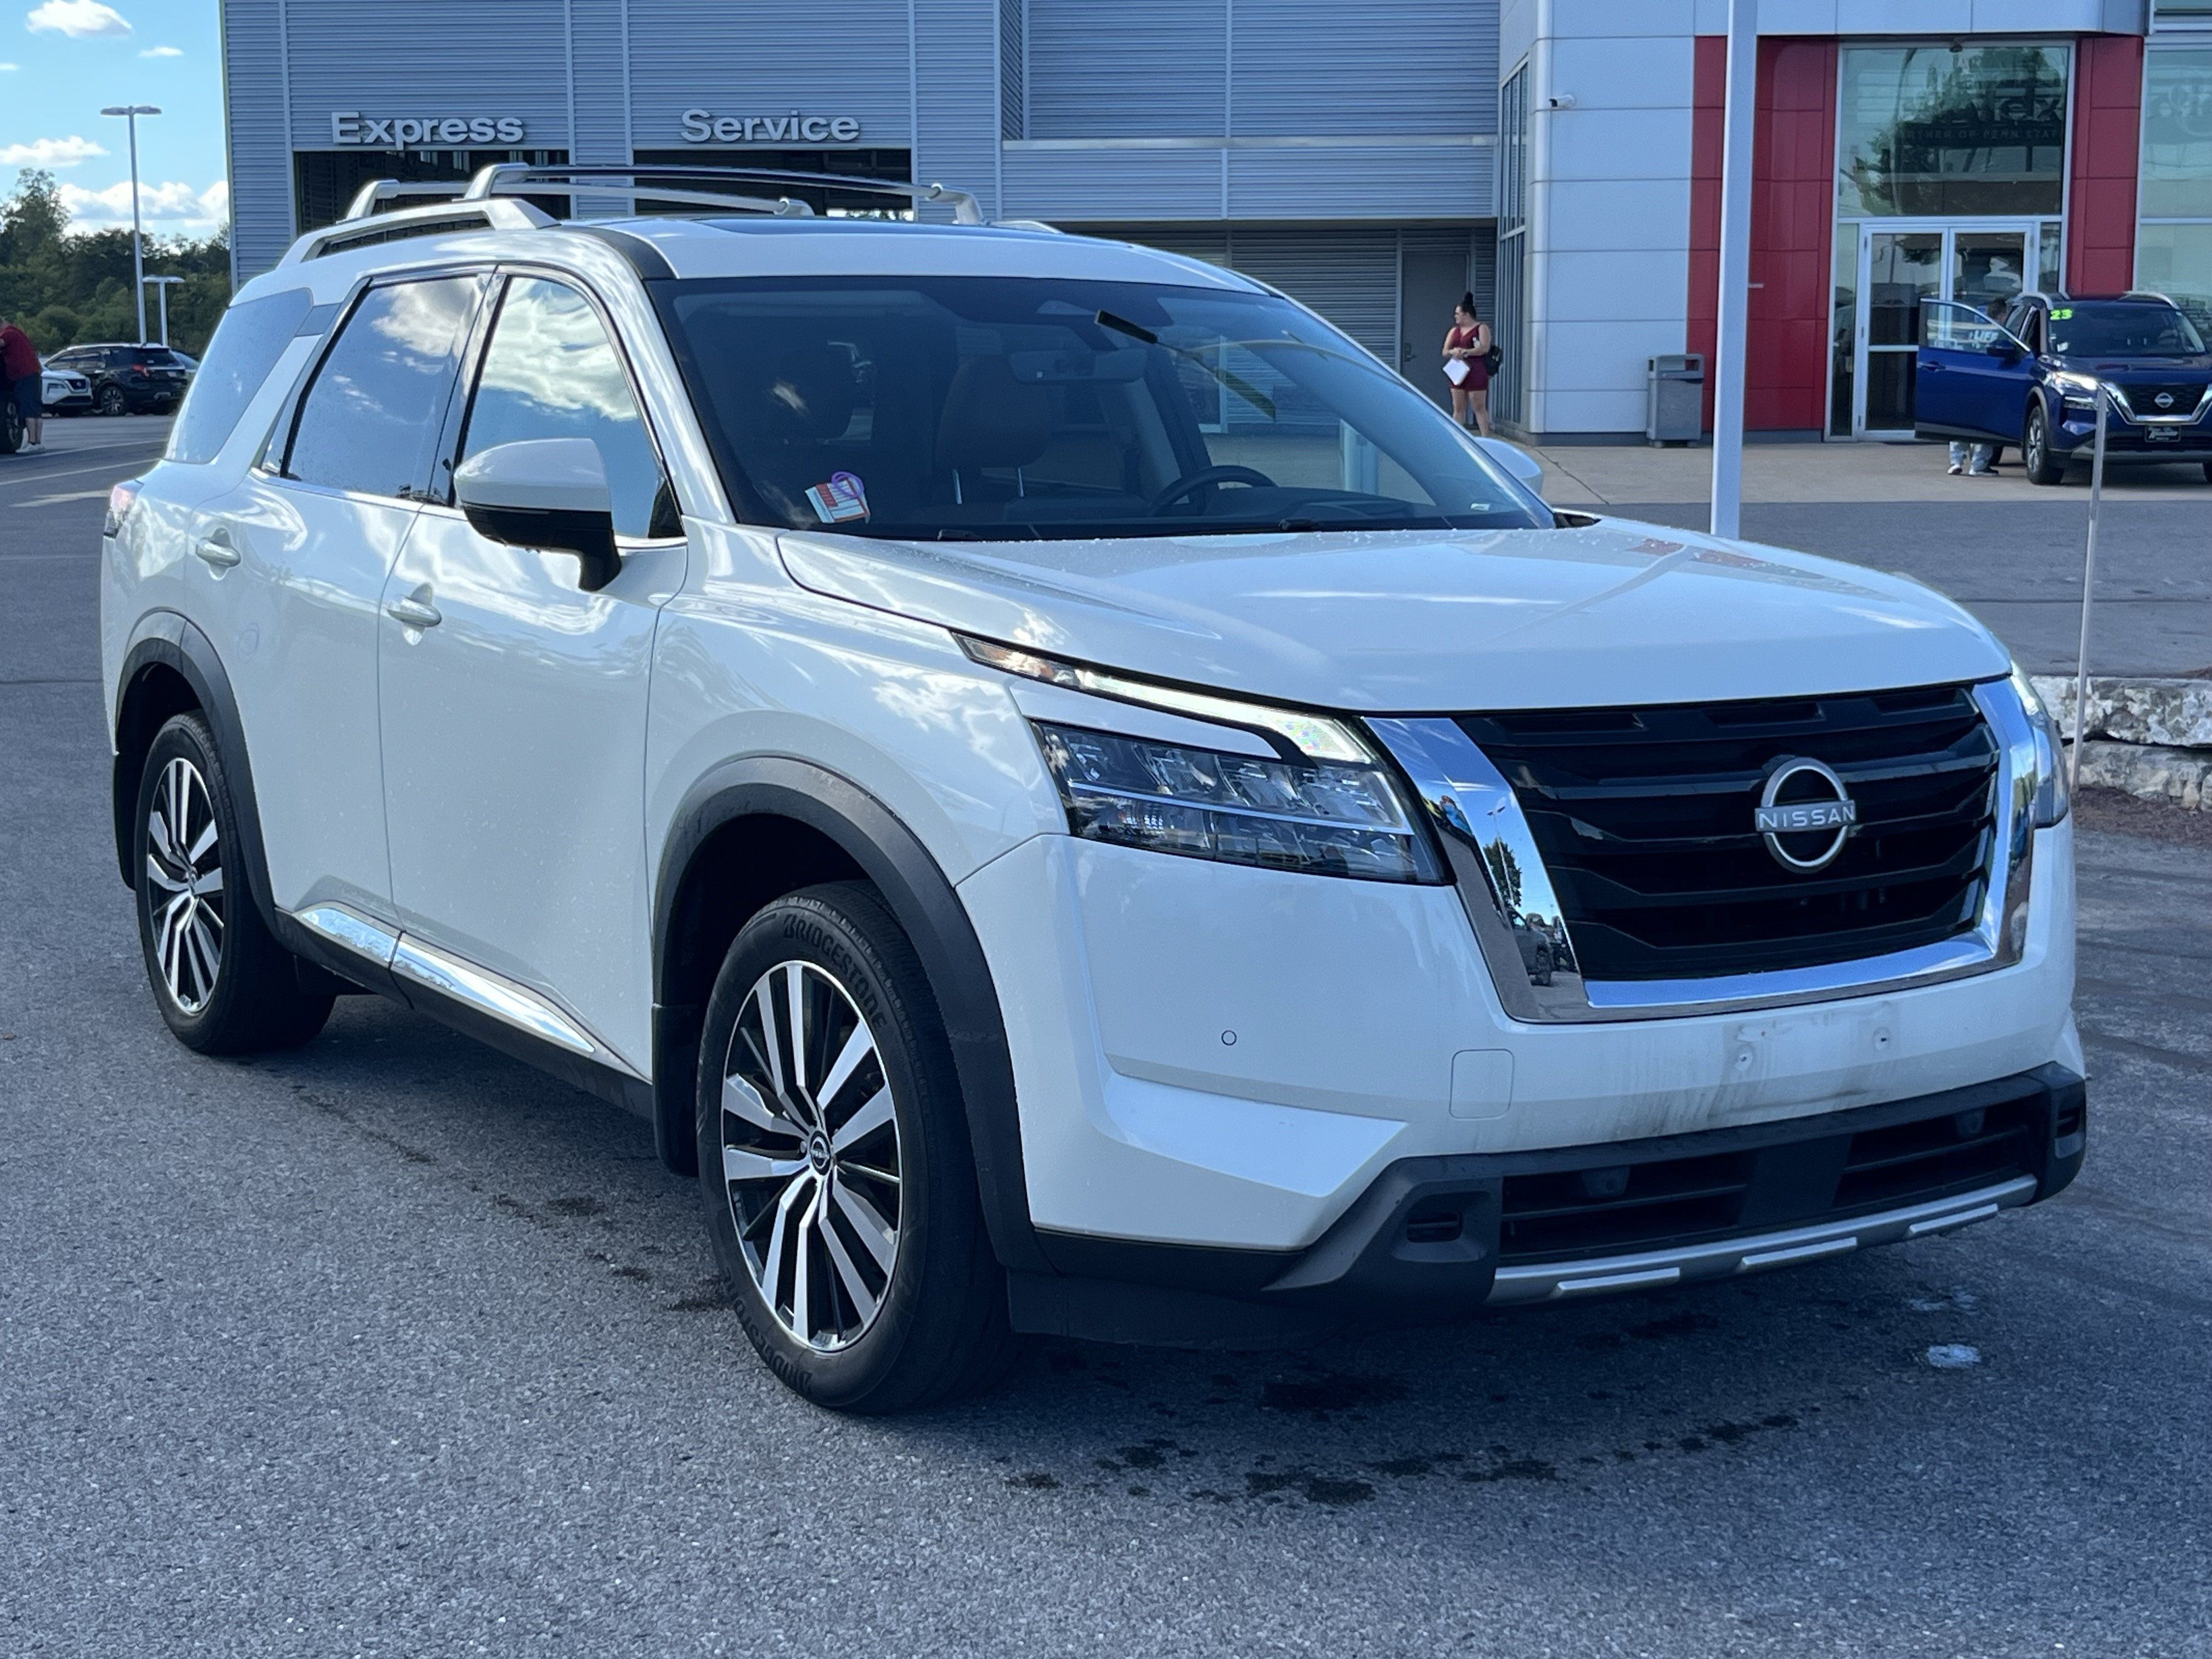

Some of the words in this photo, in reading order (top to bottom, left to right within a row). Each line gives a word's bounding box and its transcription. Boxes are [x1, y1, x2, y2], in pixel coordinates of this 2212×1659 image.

[331, 111, 523, 150] Express
[681, 109, 860, 142] Service
[1758, 805, 1855, 829] NISSAN
[783, 913, 887, 1029] BRIDGESTONE
